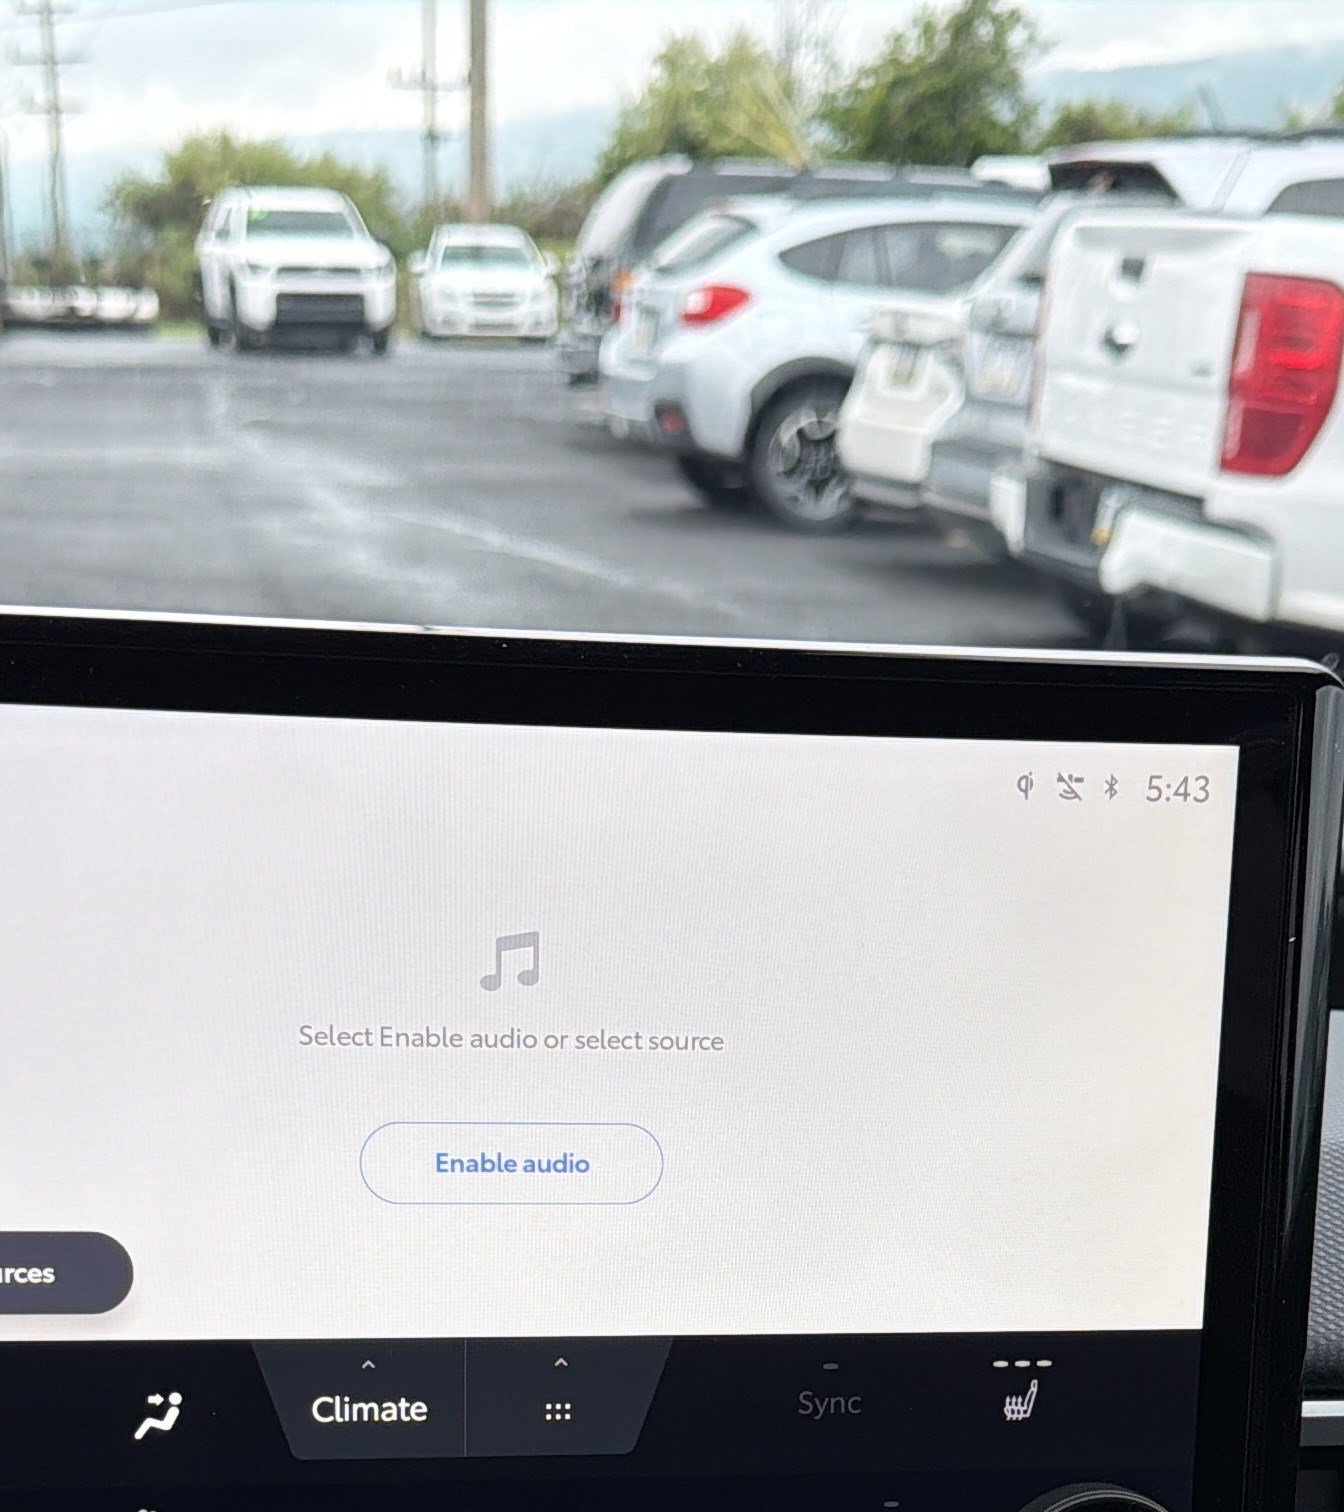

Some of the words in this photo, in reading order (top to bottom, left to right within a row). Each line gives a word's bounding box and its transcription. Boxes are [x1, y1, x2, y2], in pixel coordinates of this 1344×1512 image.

[1146, 775, 1211, 803] 5:43
[298, 1025, 374, 1048] Select
[380, 1027, 464, 1049] Enable
[470, 1028, 538, 1050] audio
[543, 1033, 568, 1050] or
[574, 1029, 643, 1051] select
[649, 1034, 725, 1051] source
[435, 1153, 517, 1173] Enable
[523, 1153, 590, 1174] audio
[311, 1394, 428, 1424] Climate
[797, 1389, 862, 1420] Sync
